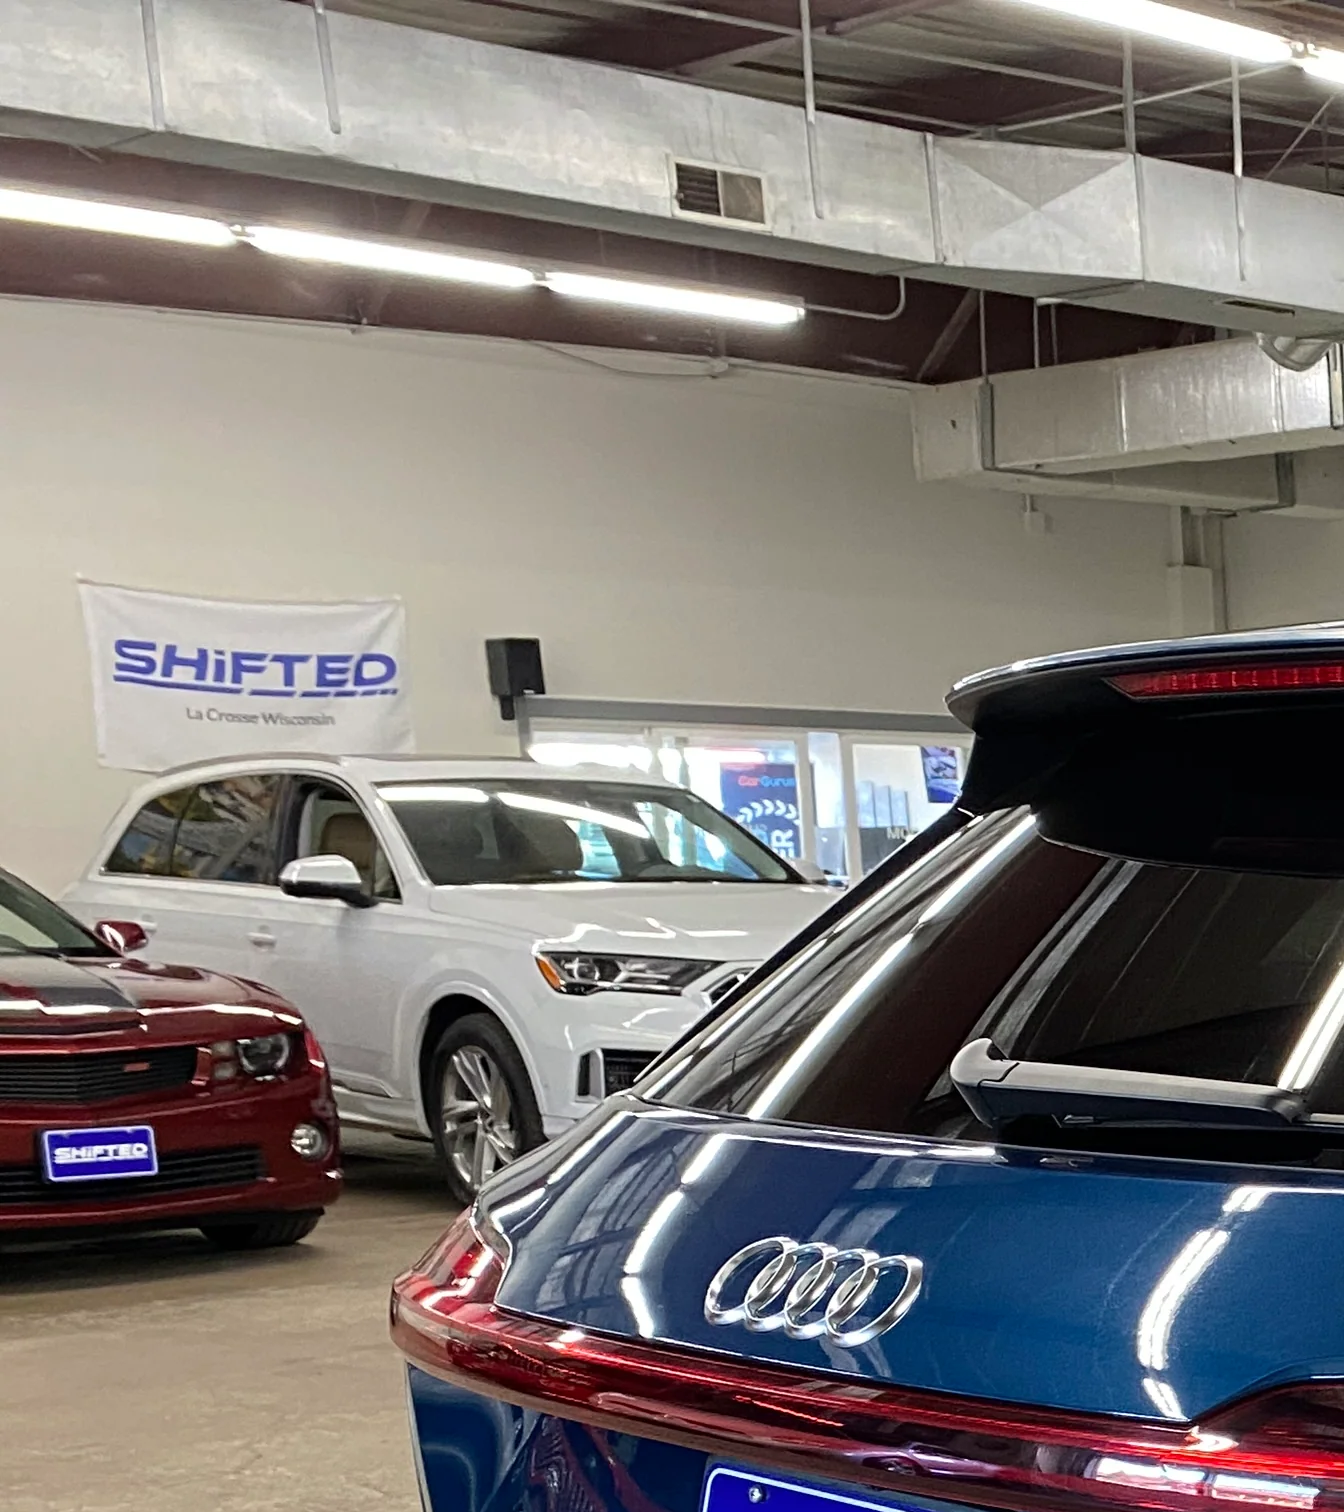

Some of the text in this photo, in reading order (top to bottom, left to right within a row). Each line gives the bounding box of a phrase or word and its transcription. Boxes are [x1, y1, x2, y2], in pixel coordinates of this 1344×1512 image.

[186, 707, 336, 727] La Crosse Wisconsin
